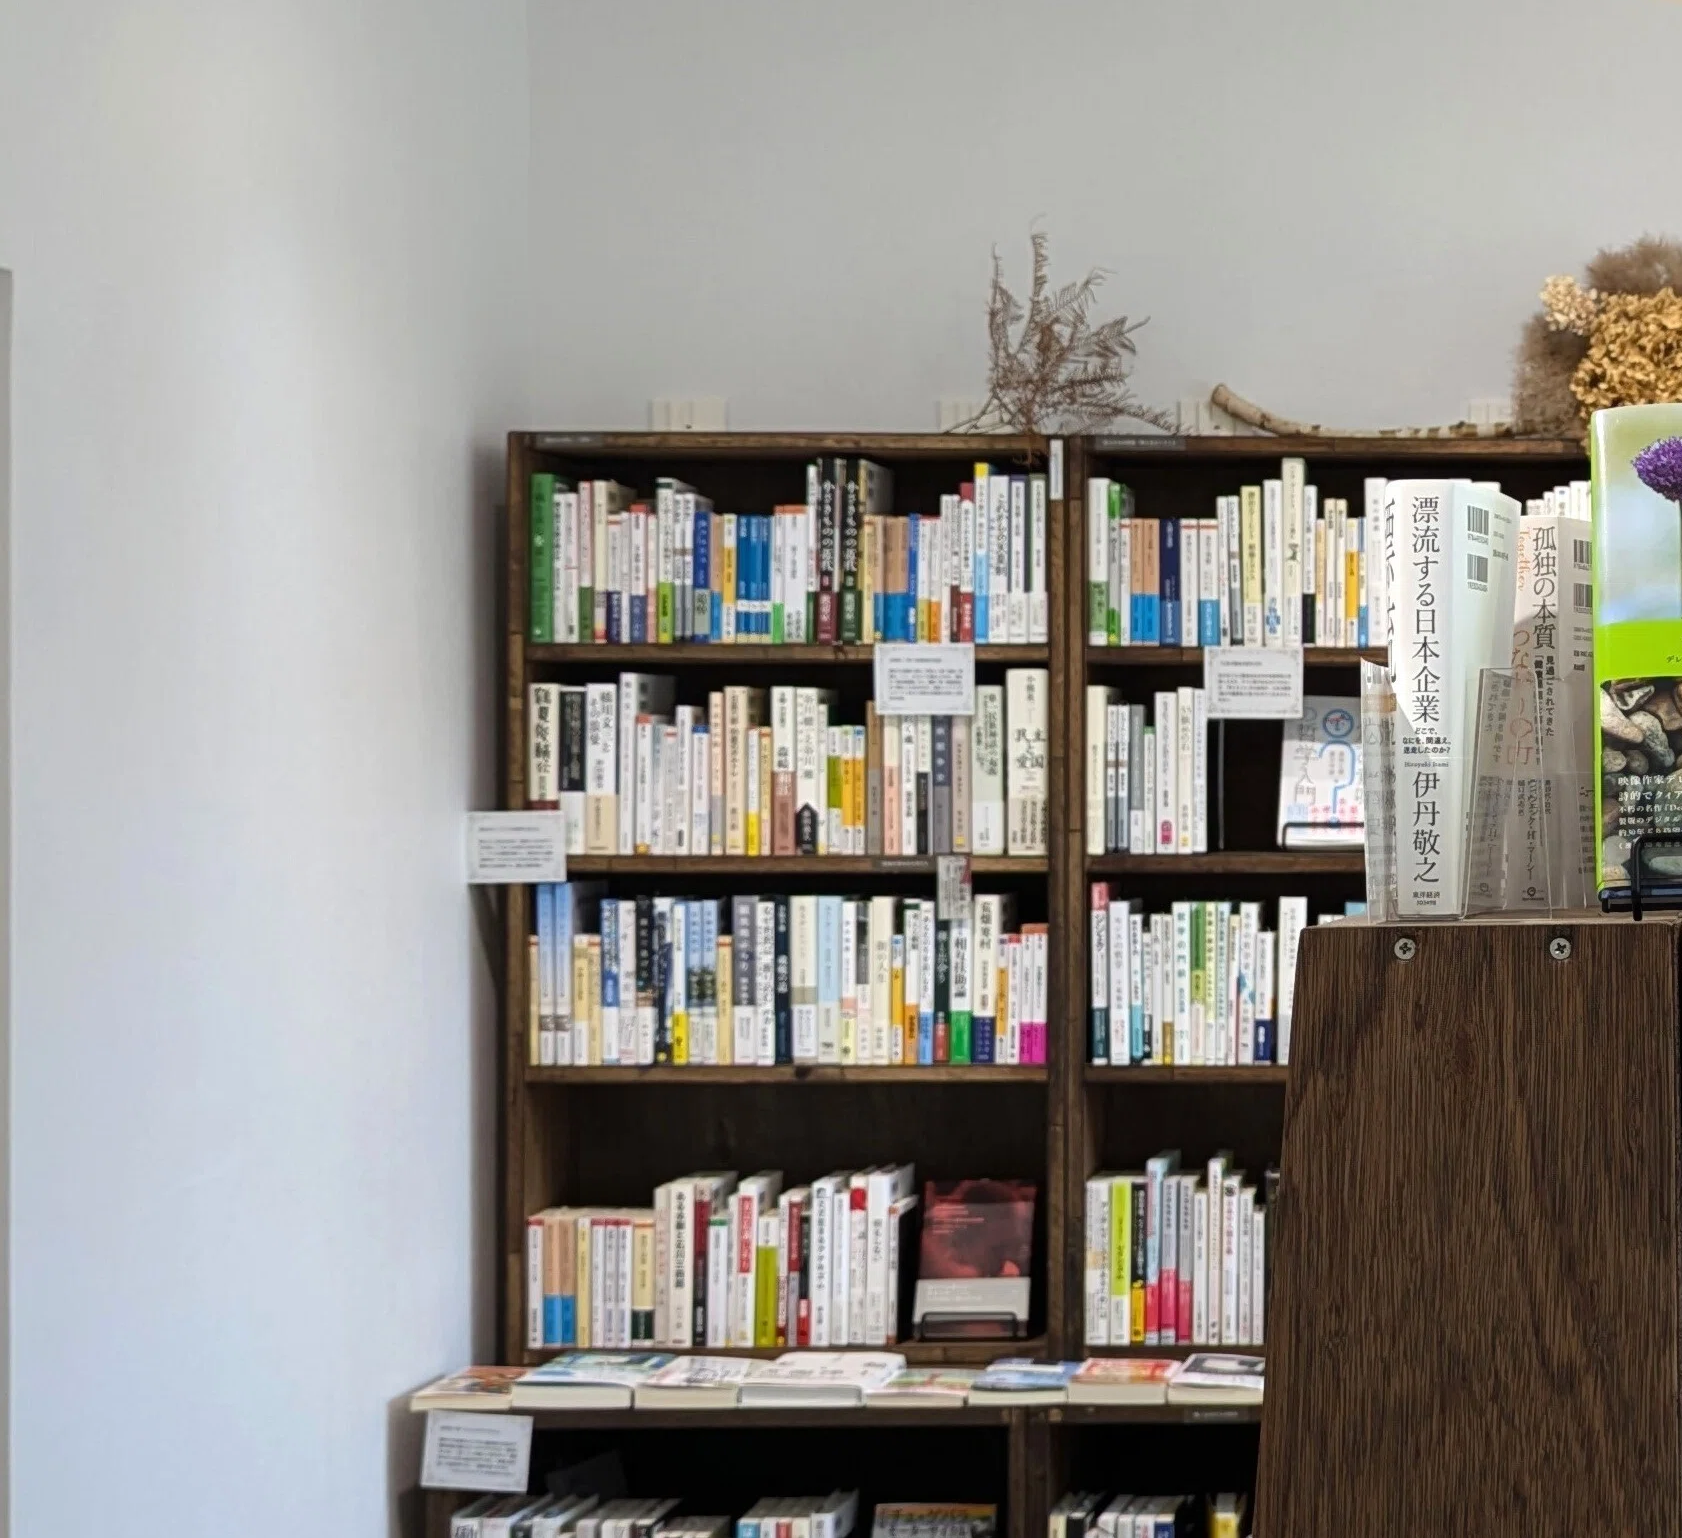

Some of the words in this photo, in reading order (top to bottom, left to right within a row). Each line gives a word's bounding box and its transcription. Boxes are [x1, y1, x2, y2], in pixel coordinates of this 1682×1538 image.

[1411, 496, 1441, 723] 漂流する日本企業
[1531, 526, 1558, 650] 孤独の本質
[1411, 771, 1441, 883] 伊丹敬之
